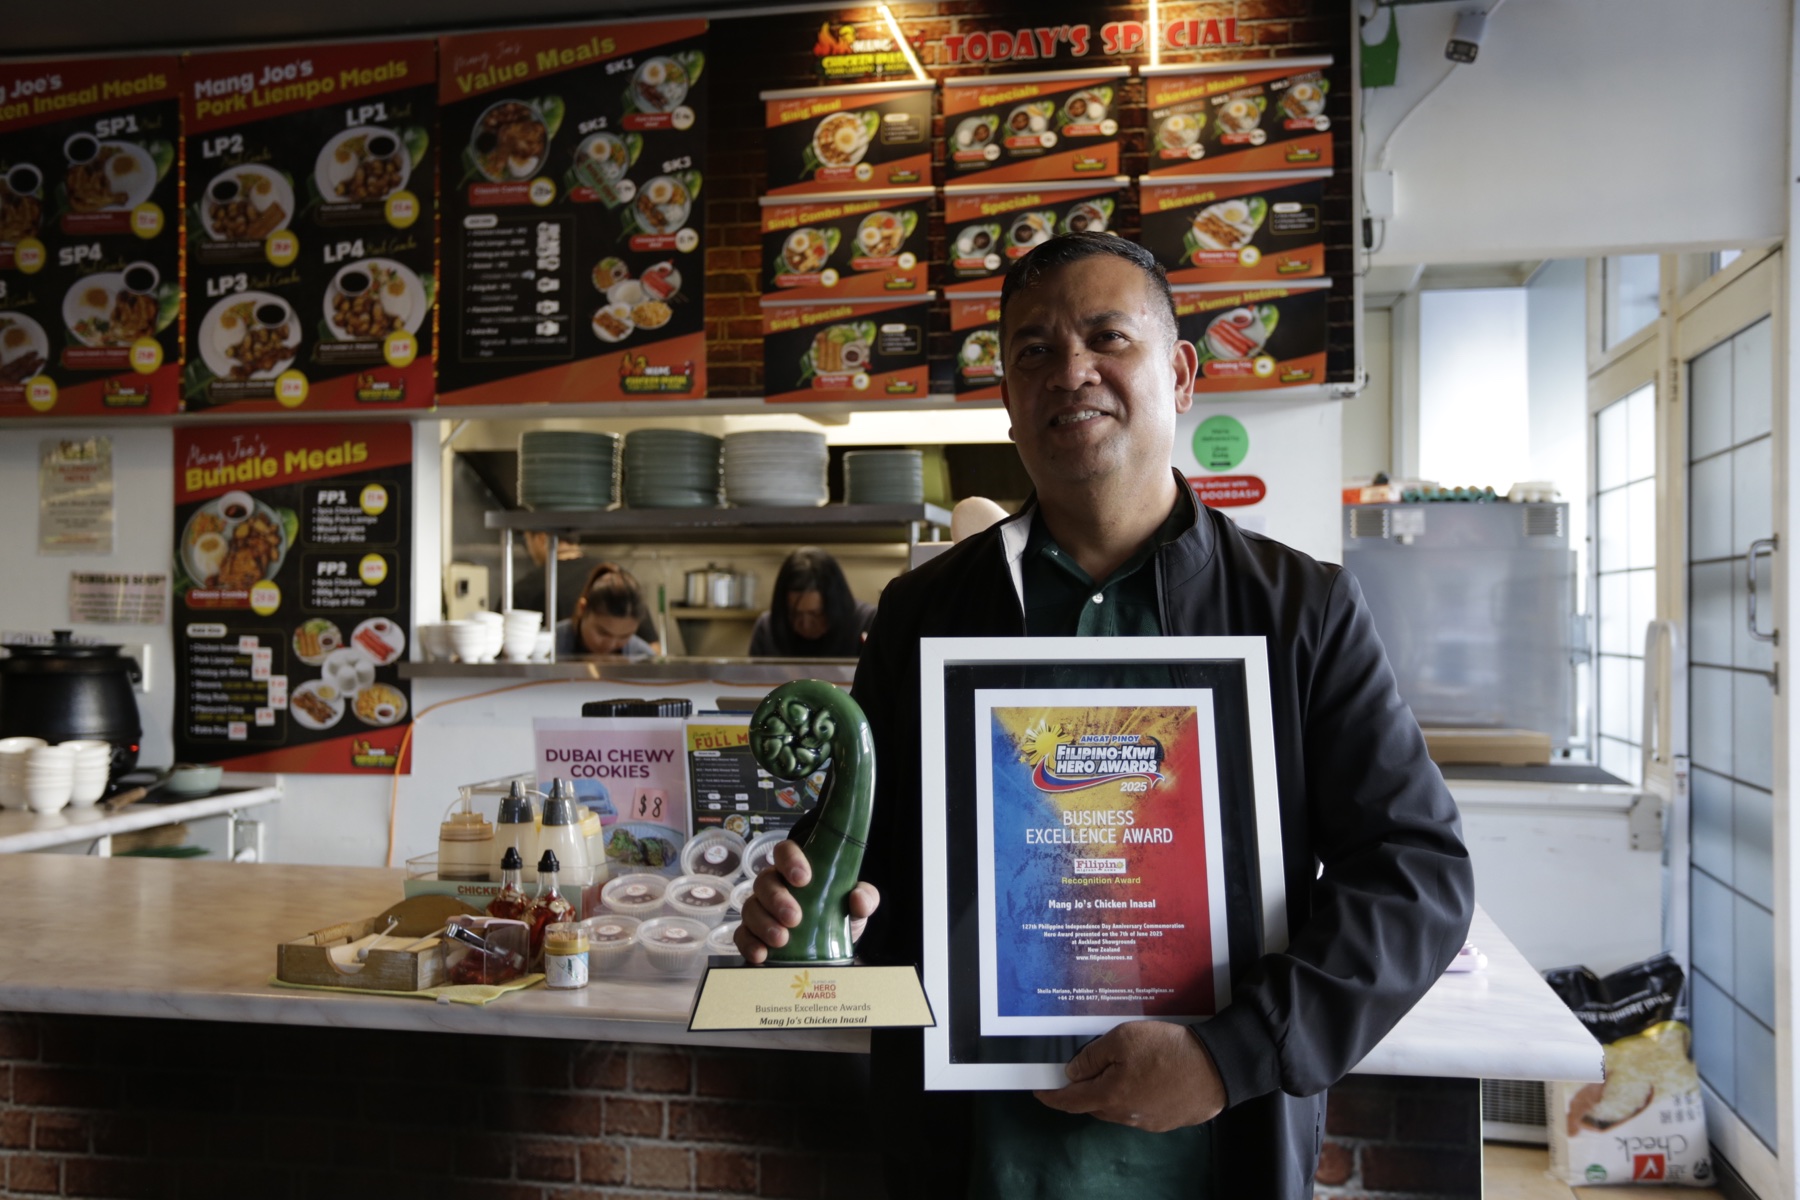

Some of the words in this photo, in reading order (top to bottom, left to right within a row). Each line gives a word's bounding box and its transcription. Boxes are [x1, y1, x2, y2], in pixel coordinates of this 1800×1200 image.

[945, 24, 1091, 64] TODAY'S
[1100, 17, 1244, 55] SPCIAL
[456, 61, 529, 94] Value
[536, 37, 616, 71] Meals
[604, 58, 635, 76] SK1
[10, 74, 64, 99] Joe's
[194, 71, 254, 99] Mang
[258, 58, 314, 86] Joe's
[33, 85, 98, 114] Inasal
[102, 72, 168, 100] Meals
[196, 93, 248, 120] Pork
[252, 76, 335, 108] Liempo
[340, 60, 408, 90] Meals
[979, 85, 1040, 106] Specials
[1156, 86, 1205, 105] Skewer
[1206, 75, 1247, 92] Meals
[346, 102, 388, 127] LP1
[95, 113, 139, 138] SP1
[577, 116, 608, 135] SK2
[202, 133, 245, 159] LP2
[662, 156, 692, 174] SK3
[980, 194, 1041, 215] Specials
[1158, 191, 1216, 210] Skewers
[799, 207, 842, 223] Combo
[58, 242, 103, 267] SP4
[323, 238, 365, 264] LP4
[206, 272, 248, 298] LP3
[1197, 294, 1242, 310] Yummy
[801, 306, 853, 324] Specials
[185, 456, 278, 493] Bundle
[284, 440, 369, 474] Meals
[186, 443, 225, 474] Mang
[317, 489, 348, 505] FP1
[1200, 489, 1260, 501] DOORDASH
[316, 561, 348, 576] FP2
[695, 735, 732, 749] FULL
[1080, 735, 1110, 743] ANGAT
[1111, 735, 1140, 743] PINOY
[546, 748, 602, 763] DUBAI
[605, 748, 675, 763] CHEWY
[1056, 745, 1156, 760] FILIPINO-KIWI
[570, 764, 650, 778] COOKIES
[1056, 760, 1094, 774] HERO
[1096, 760, 1157, 774] AWARDS
[1120, 782, 1147, 792] 2025
[652, 797, 663, 818] 8
[1063, 810, 1135, 826] BUSINESS
[1026, 828, 1117, 844] EXCELLENCE
[1122, 828, 1173, 843] AWARD
[1061, 877, 1112, 886] Recognition
[1114, 876, 1141, 884] Award
[1048, 900, 1072, 911] Mang
[1074, 899, 1092, 909] Jo's
[1094, 899, 1127, 909] Chicken
[1129, 899, 1156, 908] Inasal
[1065, 923, 1100, 931] Independence
[755, 1004, 792, 1013] Business
[794, 1004, 838, 1012] Excellence
[839, 1003, 871, 1011] Awards
[759, 1017, 785, 1026] Mang
[786, 1016, 802, 1026] Jo's
[803, 1016, 838, 1025] Chicken
[840, 1015, 868, 1024] Inasal
